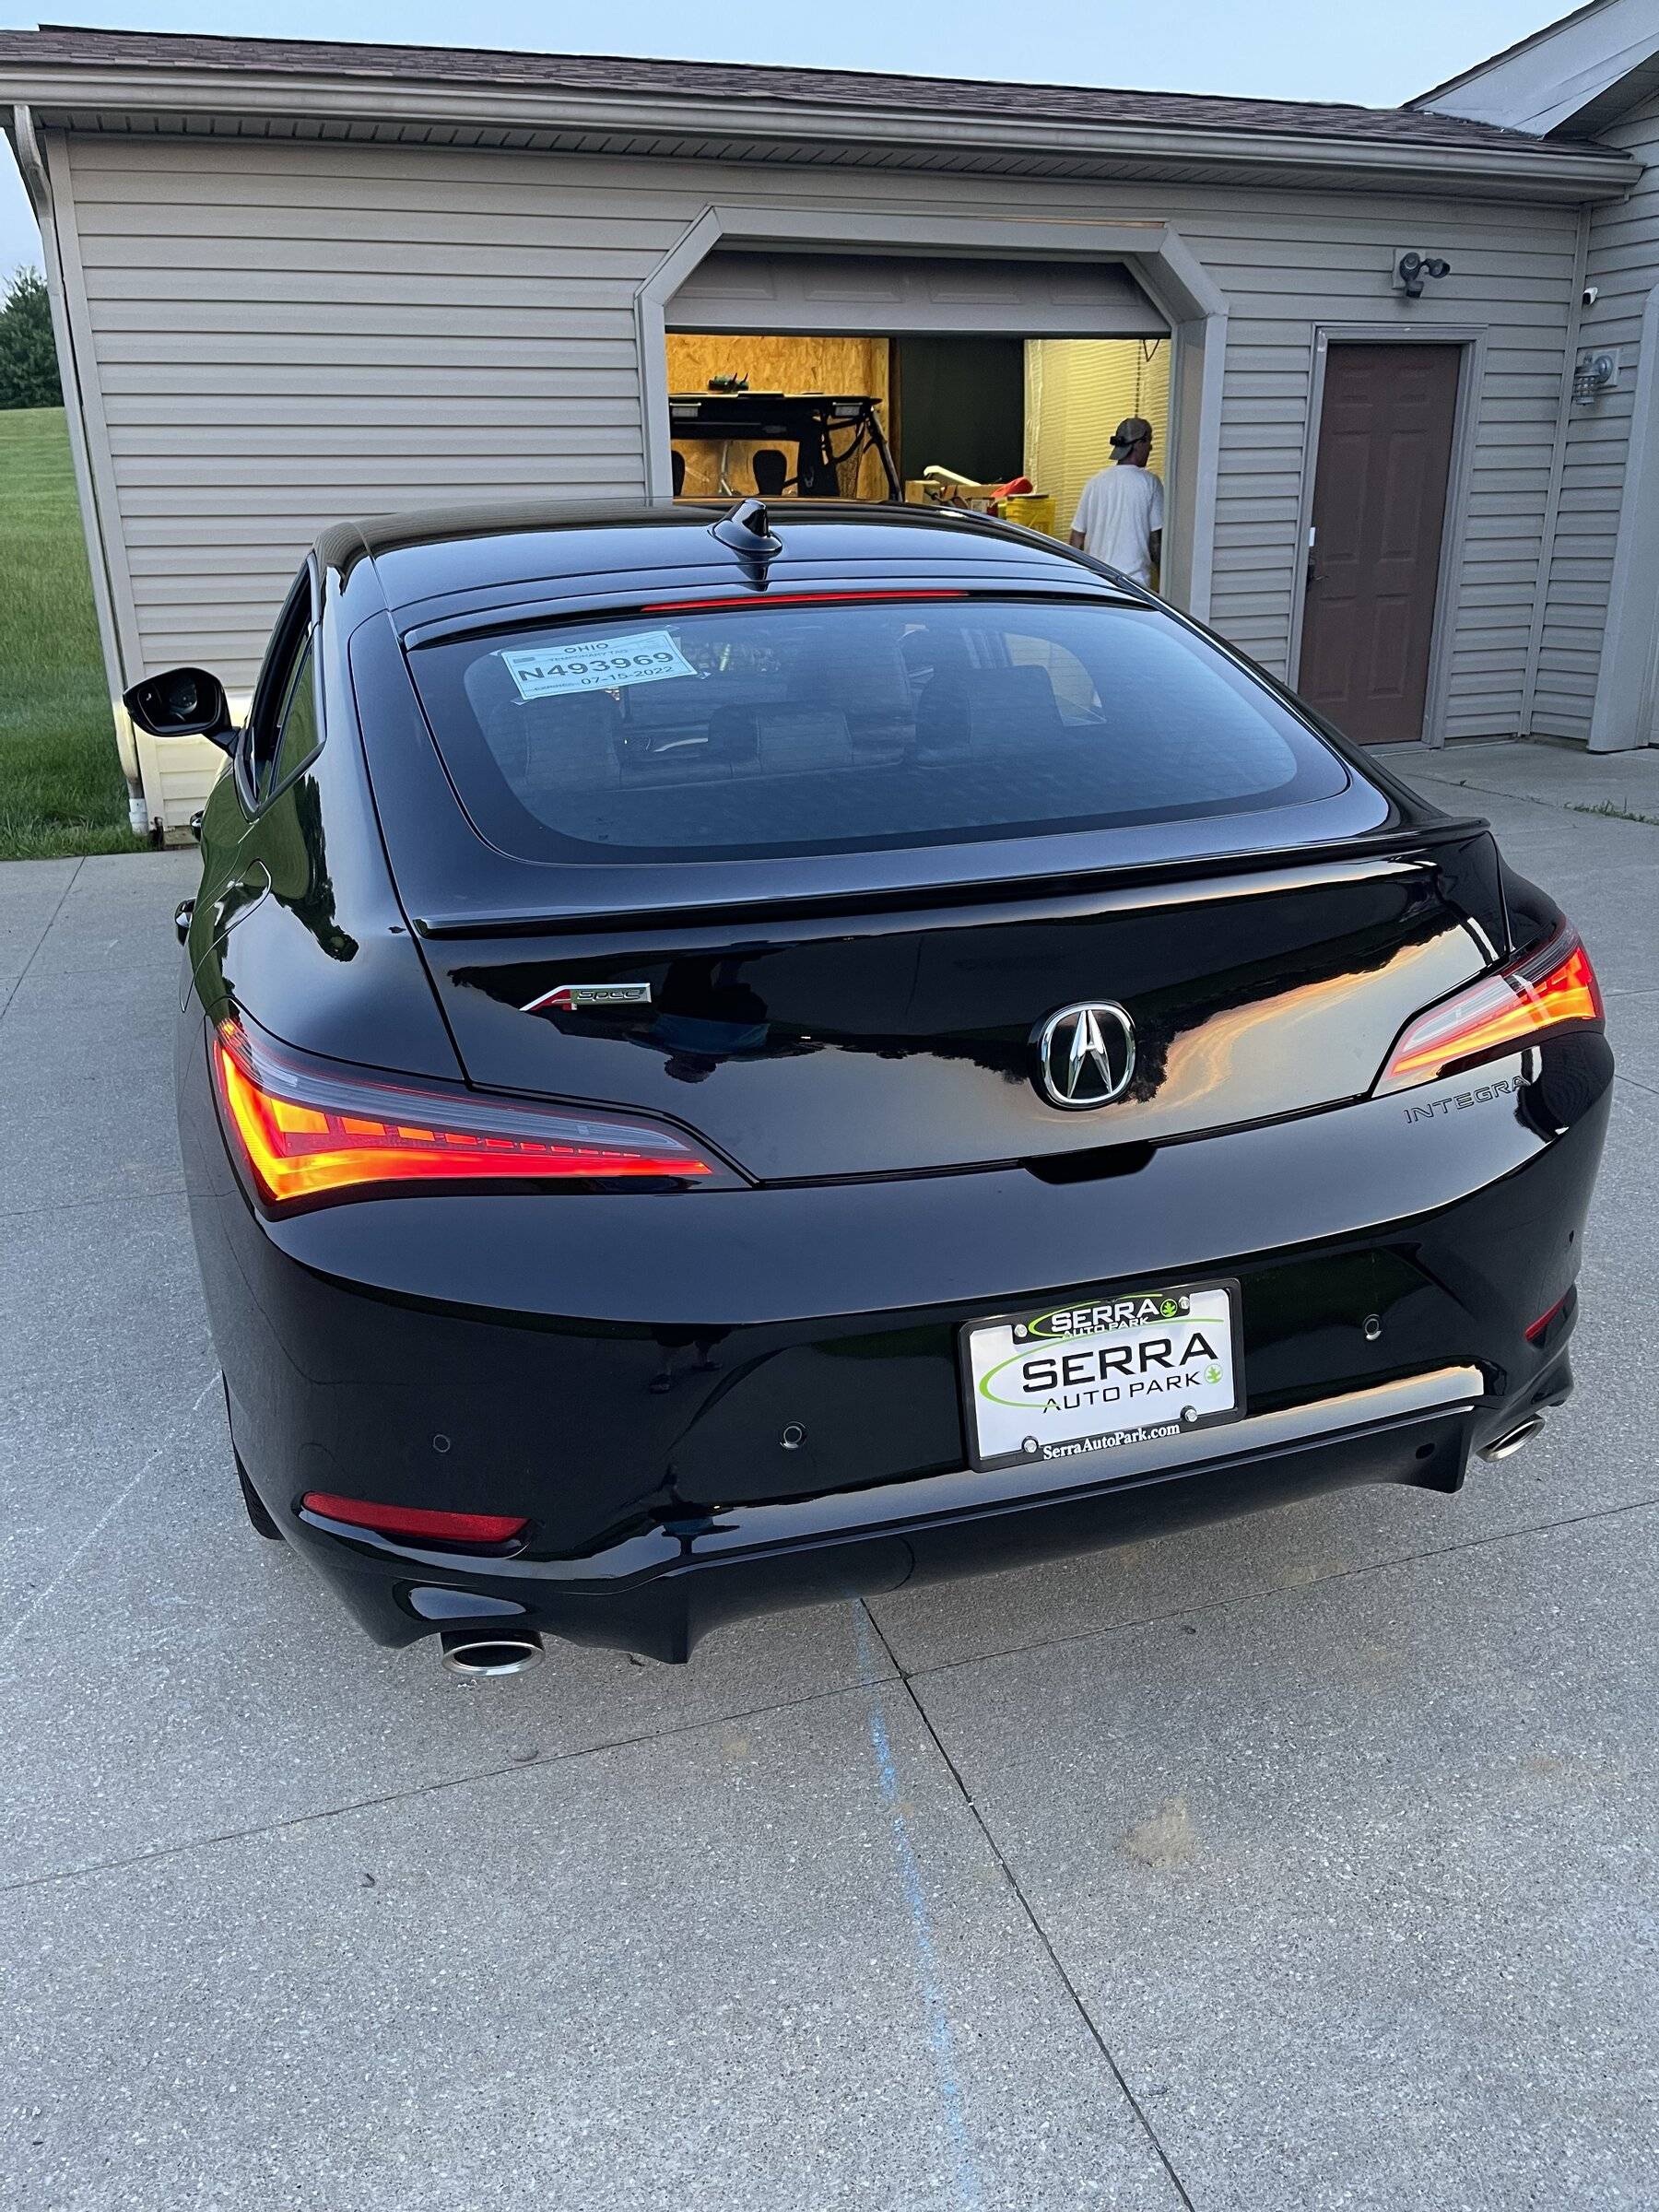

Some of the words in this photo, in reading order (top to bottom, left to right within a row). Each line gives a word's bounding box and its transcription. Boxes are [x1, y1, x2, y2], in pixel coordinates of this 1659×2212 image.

[564, 642, 608, 653] OHIO
[518, 652, 674, 681] N493969
[581, 666, 674, 685] 07-15-2022
[1403, 1075, 1531, 1124] INTEGRA
[1051, 1298, 1159, 1333] SERRA
[1062, 1324, 1104, 1340] AUTO
[1109, 1316, 1149, 1330] PARK
[1022, 1332, 1218, 1394] SERRA
[1043, 1386, 1120, 1414] AUTO
[1129, 1371, 1202, 1398] PARK
[1042, 1423, 1181, 1460] SerraAutoPark.com
